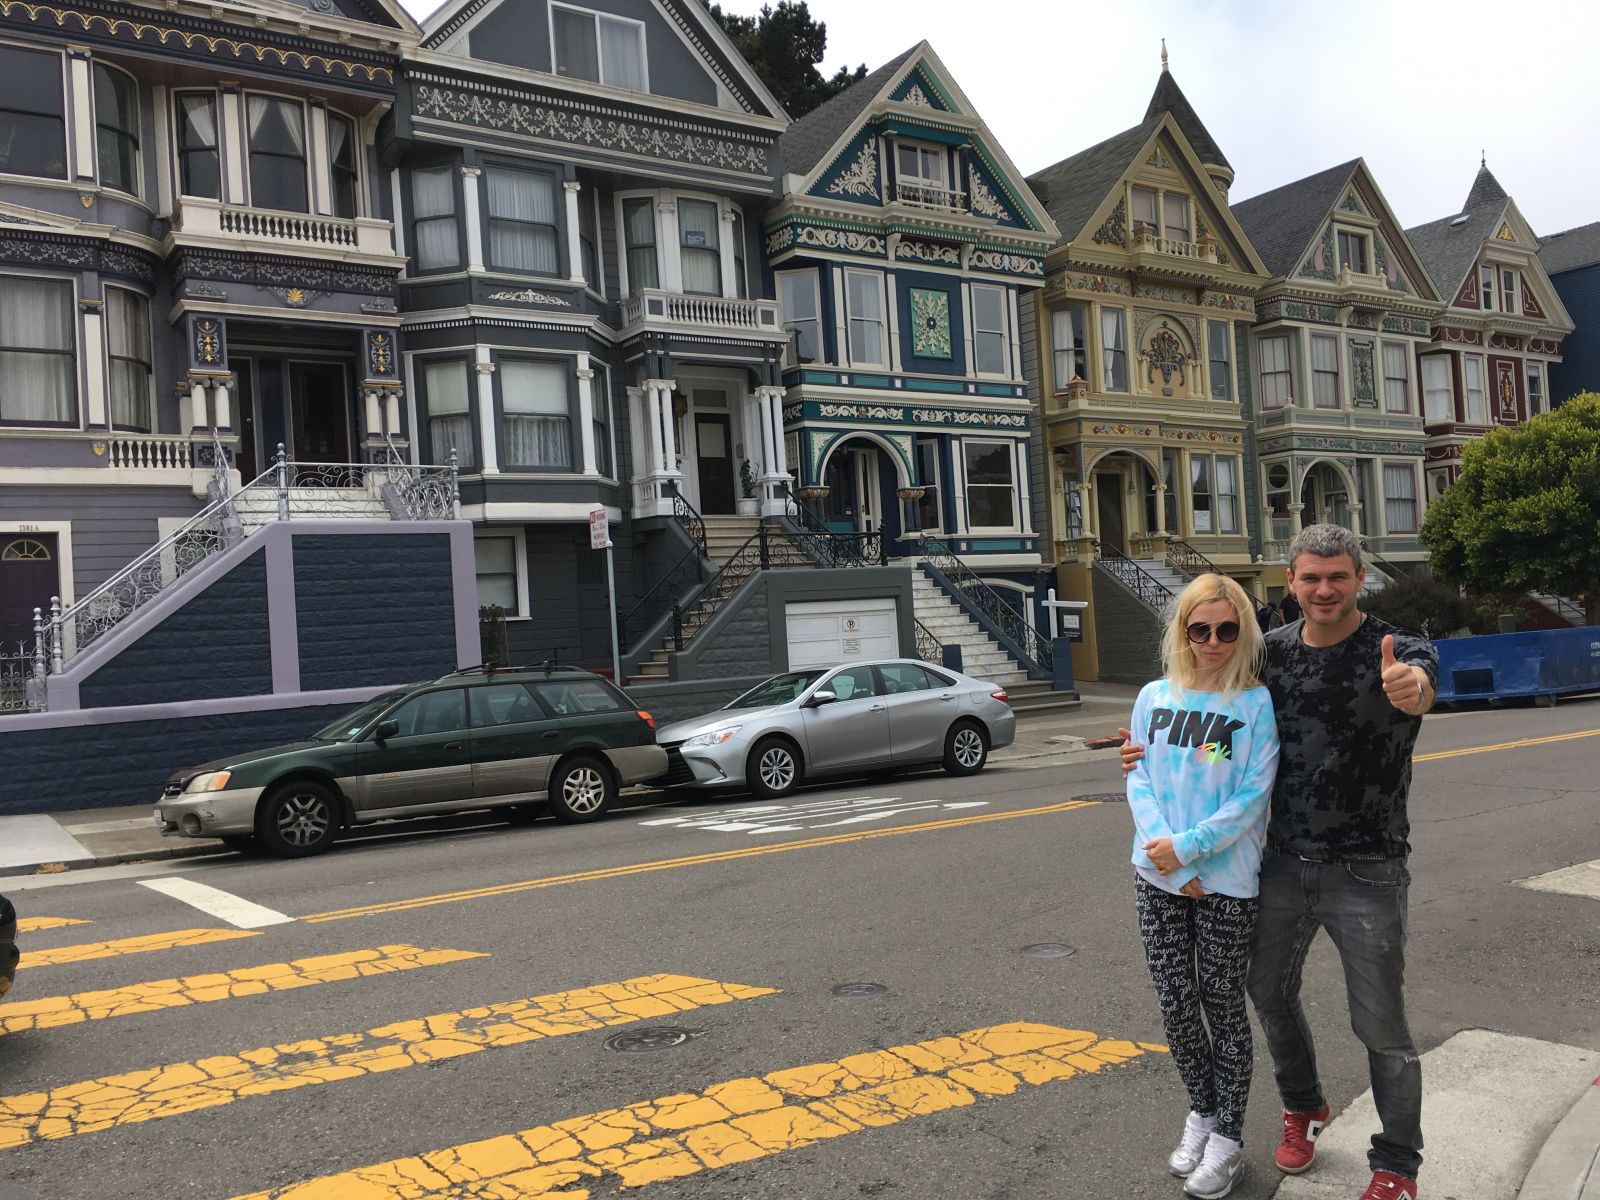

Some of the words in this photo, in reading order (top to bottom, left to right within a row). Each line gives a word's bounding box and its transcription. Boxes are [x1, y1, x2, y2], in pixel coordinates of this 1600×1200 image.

[1148, 708, 1246, 760] PINK
[1221, 900, 1242, 914] VS
[1164, 929, 1188, 943] Love
[1210, 977, 1233, 990] VS
[1217, 1039, 1240, 1054] VS
[1217, 1107, 1234, 1122] VS
